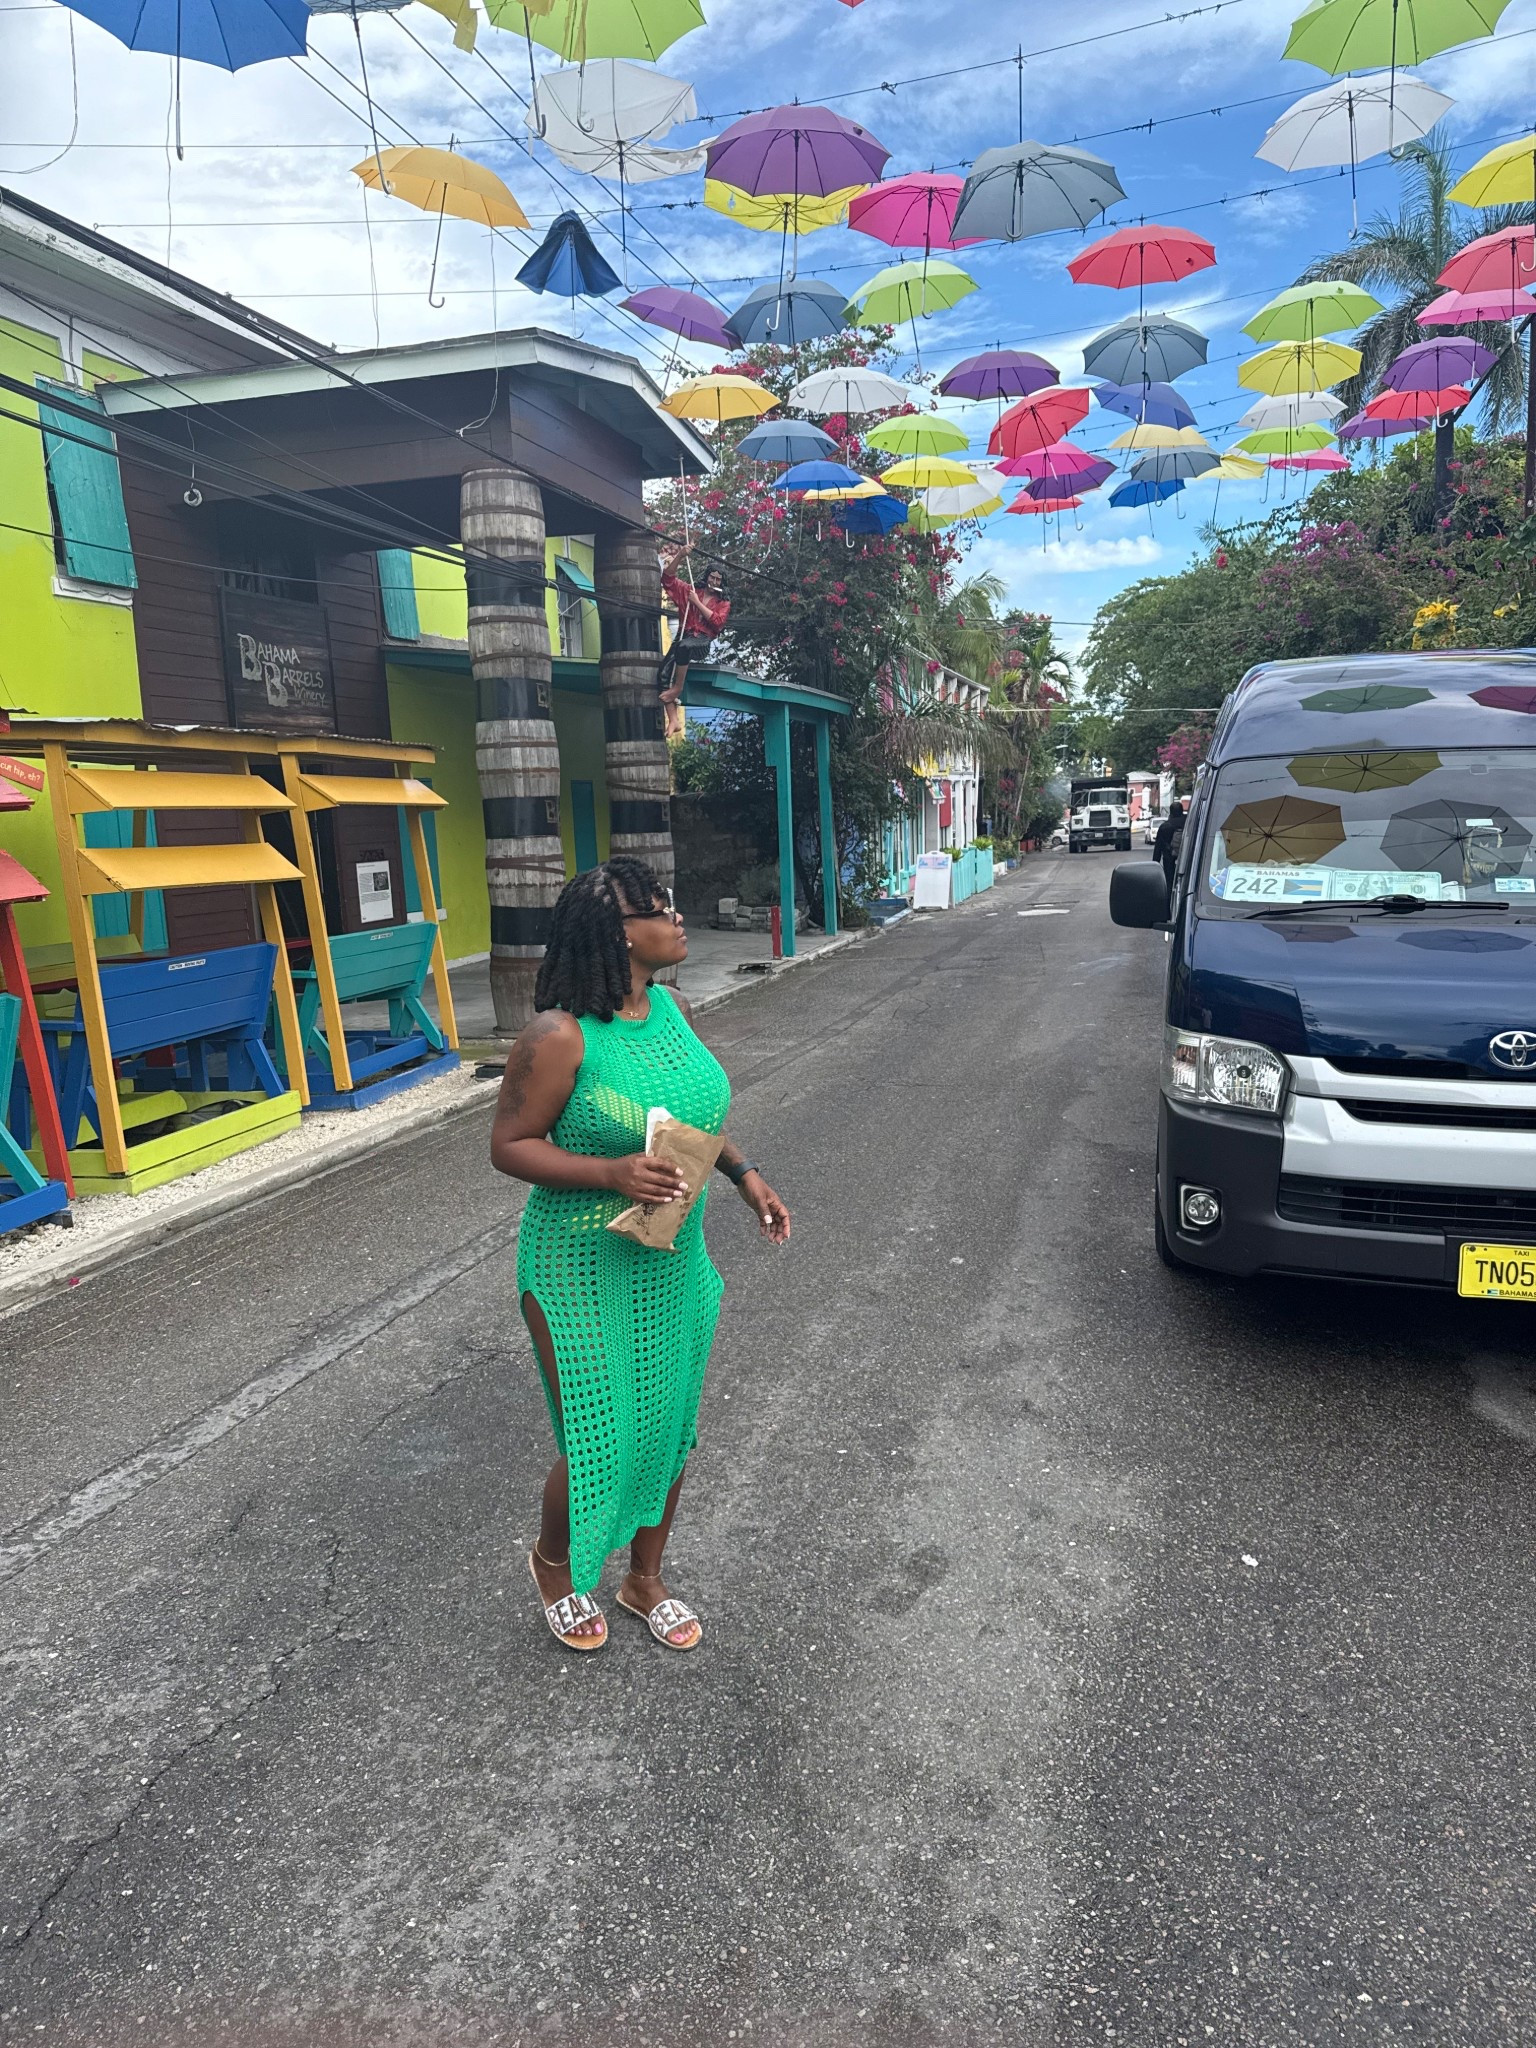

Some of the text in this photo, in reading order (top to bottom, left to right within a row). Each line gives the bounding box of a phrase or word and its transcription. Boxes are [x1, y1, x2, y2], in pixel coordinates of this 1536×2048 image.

[237, 633, 300, 681] BAHAMA
[262, 661, 324, 707] BARRELS
[294, 685, 325, 707] Winery
[1232, 878, 1278, 895] 242
